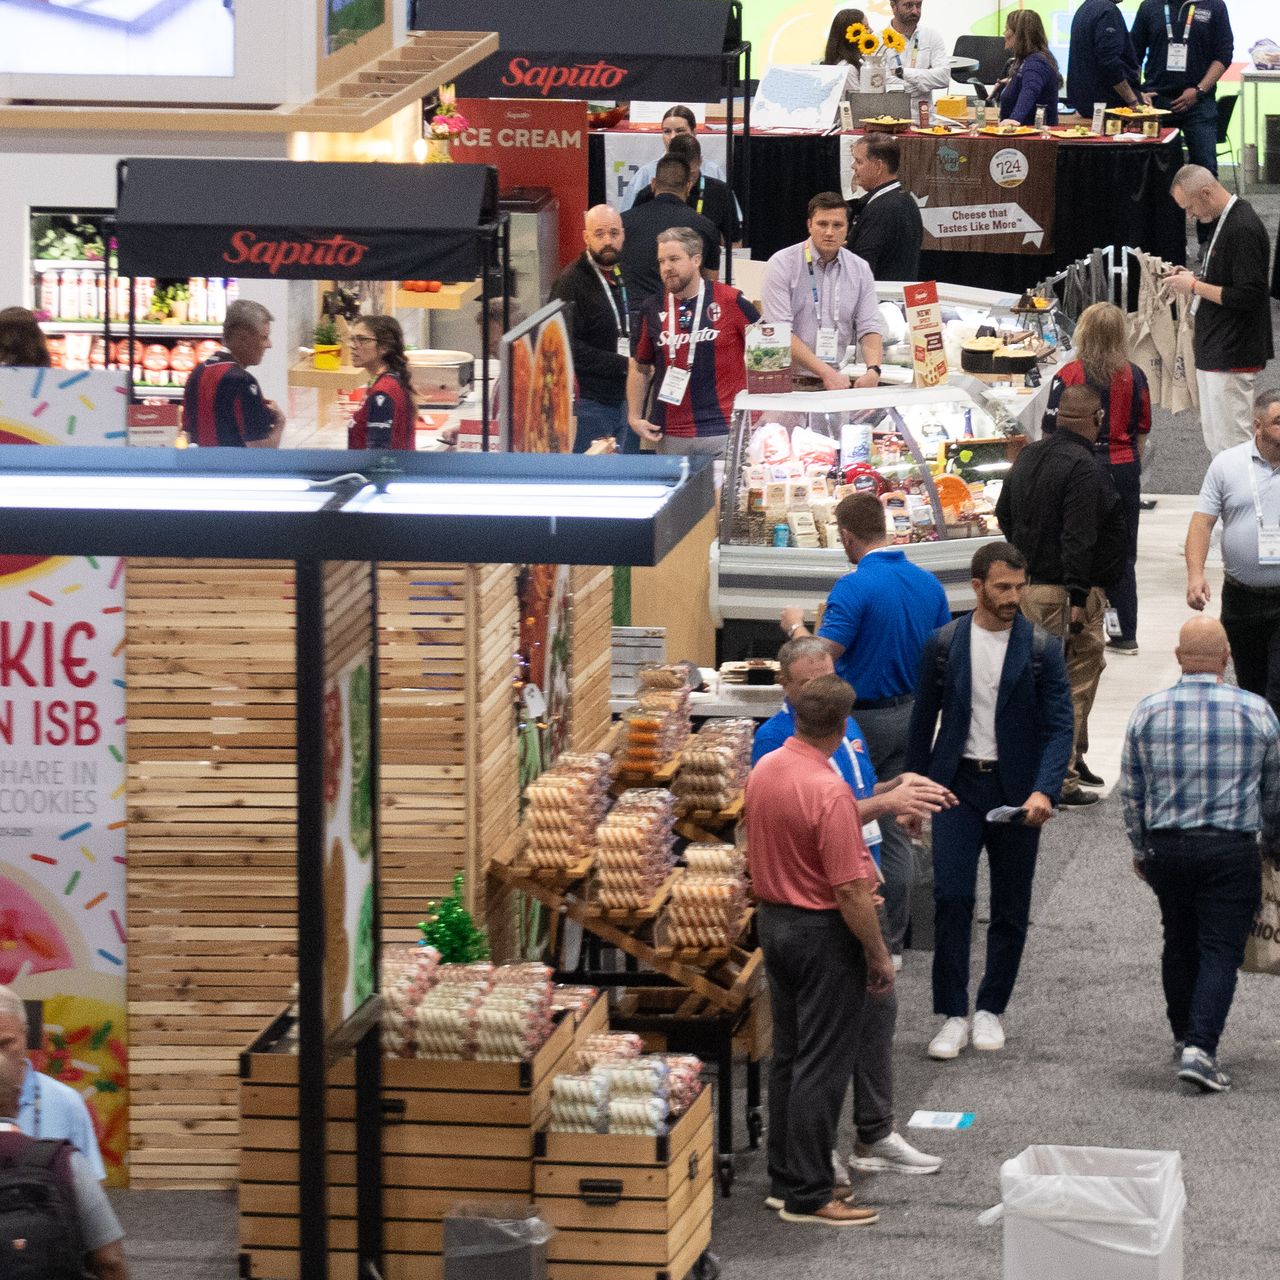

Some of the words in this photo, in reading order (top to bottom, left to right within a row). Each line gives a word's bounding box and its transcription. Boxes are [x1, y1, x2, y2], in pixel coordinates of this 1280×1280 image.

[501, 57, 628, 97] Saputo
[497, 127, 582, 149] CREAM
[996, 160, 1022, 175] 724
[952, 210, 987, 221] Cheese
[988, 208, 1008, 219] that
[938, 223, 968, 233] Tastes
[970, 221, 991, 232] Like
[992, 220, 1017, 231] More
[223, 229, 369, 276] Saputo
[657, 327, 721, 348] Saputo
[33, 699, 102, 746] ISB
[73, 761, 99, 786] IN
